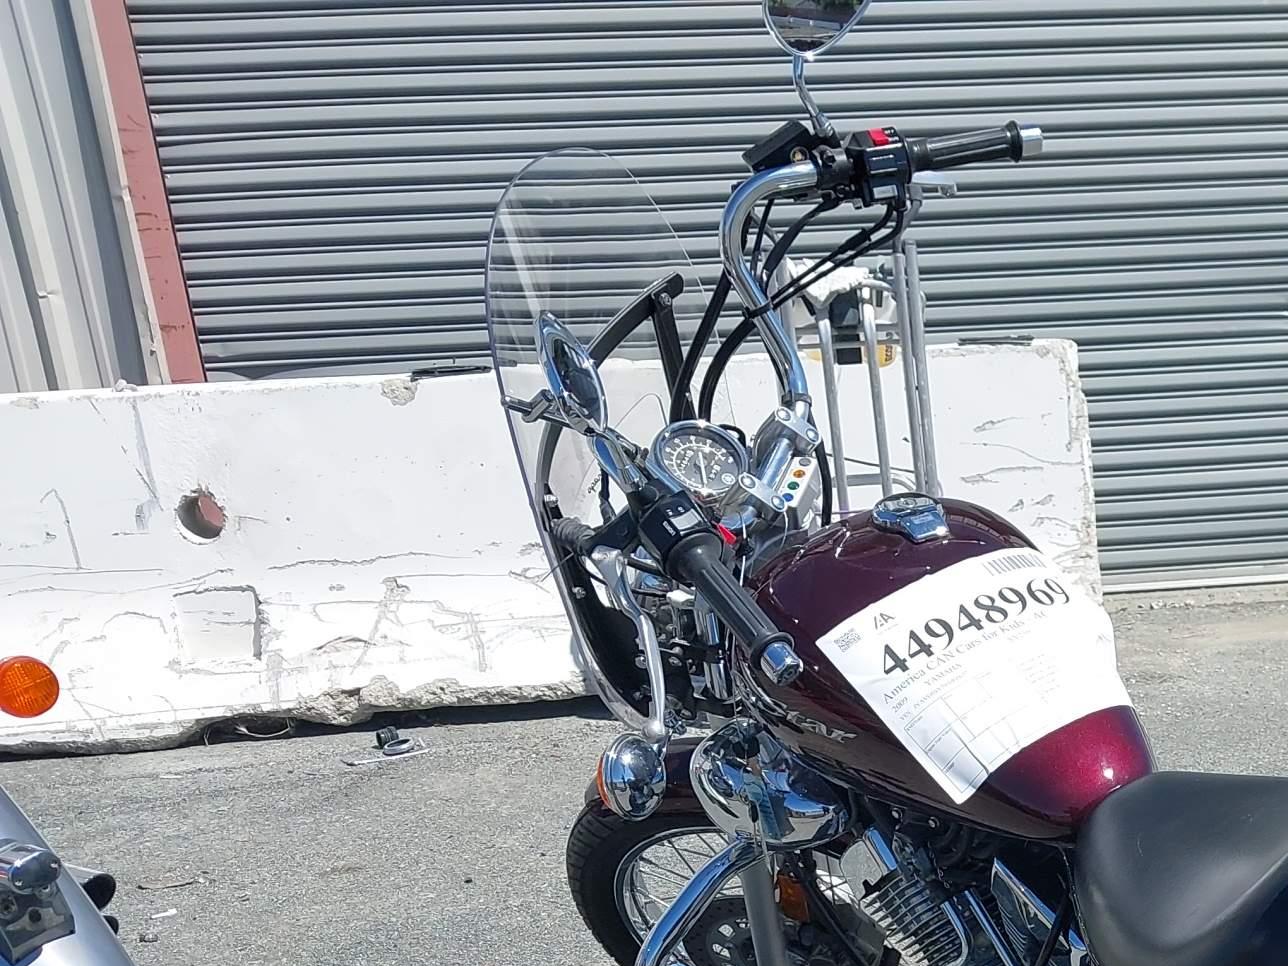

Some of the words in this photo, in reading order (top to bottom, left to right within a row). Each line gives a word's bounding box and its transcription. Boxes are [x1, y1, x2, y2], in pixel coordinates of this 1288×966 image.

[883, 578, 1070, 675] 44948969
[883, 669, 926, 704] America
[926, 651, 956, 671] CAN
[955, 637, 982, 655] Cars
[982, 629, 999, 641] for
